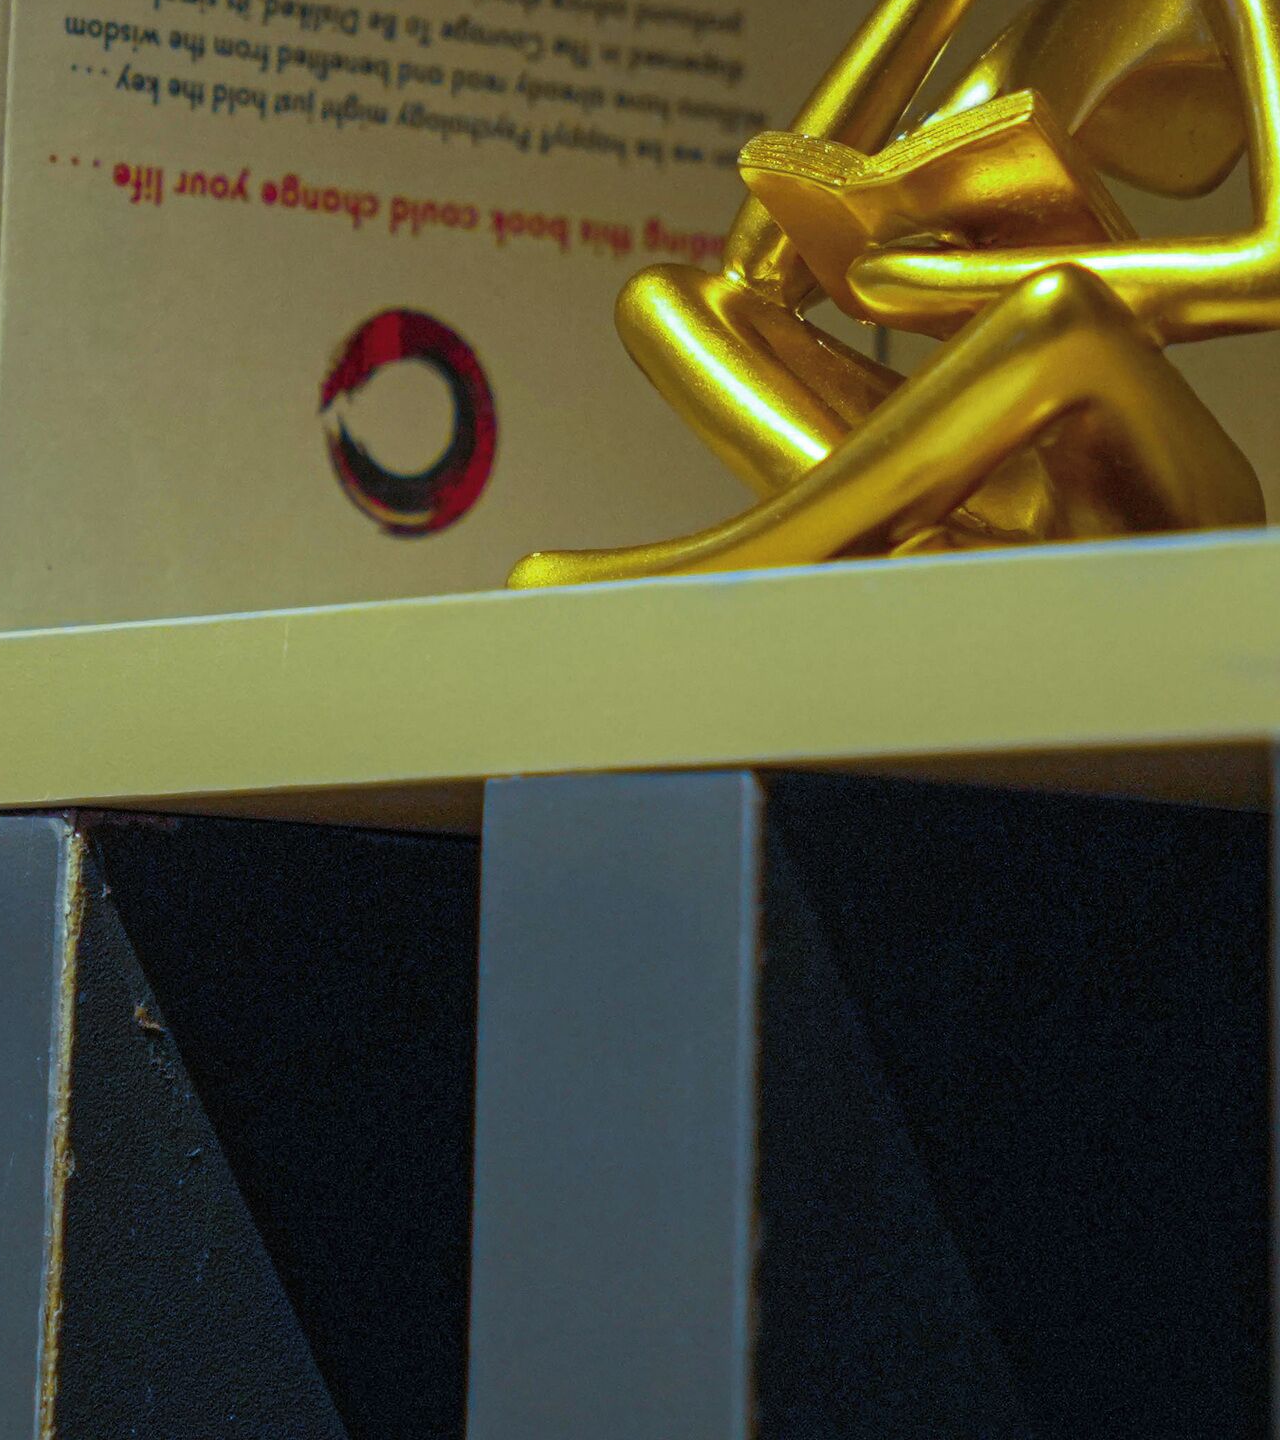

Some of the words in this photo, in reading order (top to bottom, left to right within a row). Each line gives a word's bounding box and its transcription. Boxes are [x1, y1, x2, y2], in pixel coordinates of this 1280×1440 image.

[63, 15, 160, 51] wisdom
[168, 29, 206, 61] the
[367, 11, 397, 42] Be
[403, 15, 432, 47] To
[212, 36, 270, 73] from
[276, 44, 391, 89] benefited
[115, 63, 160, 105] key
[396, 62, 446, 86] and
[450, 68, 507, 95] read
[167, 76, 205, 110] the
[210, 82, 267, 120] hold
[272, 90, 315, 115] just
[320, 93, 389, 129] might
[395, 101, 532, 152] Psychology
[111, 161, 163, 205] life
[172, 166, 249, 202] your
[260, 171, 379, 227] change
[387, 194, 480, 237] could
[489, 209, 570, 251] book
[579, 217, 632, 258] this
[640, 218, 730, 276] ading
